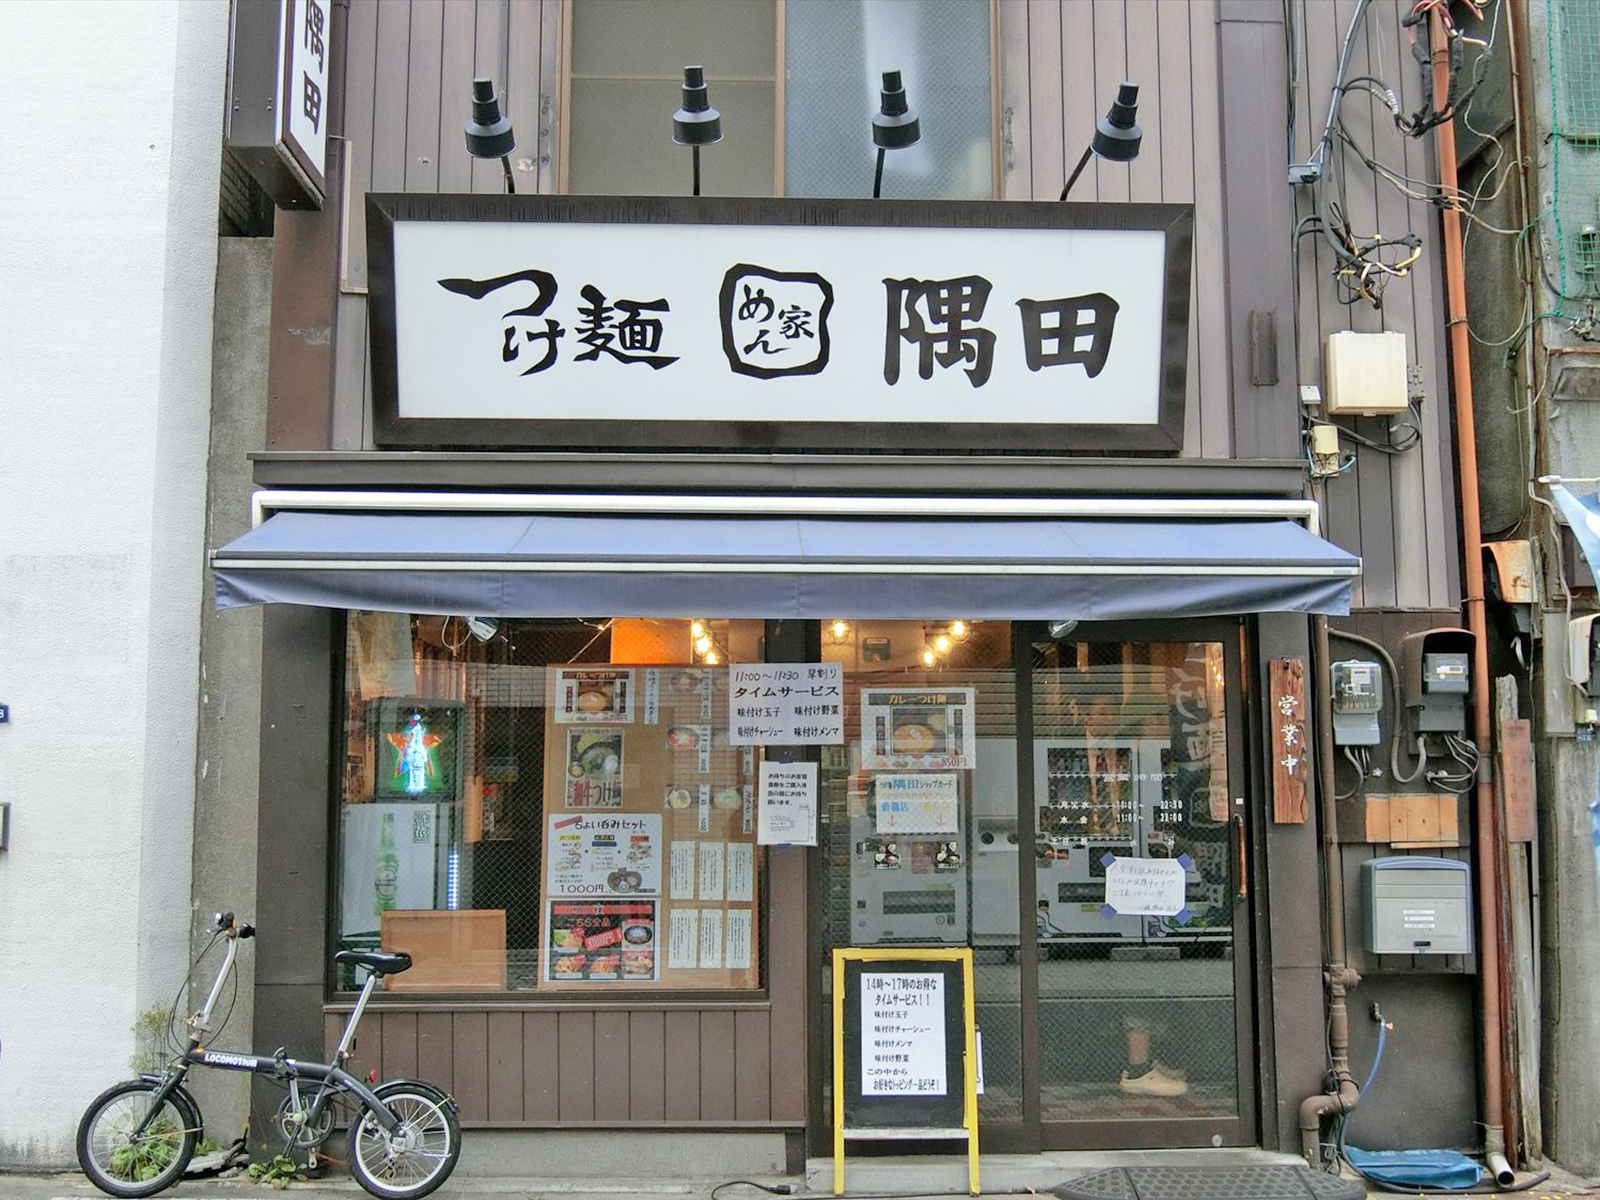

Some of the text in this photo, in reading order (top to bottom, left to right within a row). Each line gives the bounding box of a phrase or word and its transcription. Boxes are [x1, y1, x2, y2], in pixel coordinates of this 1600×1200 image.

[437, 268, 681, 377] つけ麺
[881, 275, 1121, 388] 隅田
[807, 668, 837, 680] 早割り
[734, 685, 839, 698] タイムサービス
[889, 694, 947, 704] カレーつけ麺
[737, 705, 839, 718] 味付け玉子 味付け野菜
[737, 726, 839, 738] 味付けチャーシュー 味付けメンマ
[1278, 695, 1299, 776] 営業中
[560, 884, 604, 893] 1000円
[874, 1010, 909, 1019] 味付け玉子
[874, 1025, 931, 1034] 味付けチャーシュー
[874, 1054, 910, 1063] 味付け野菜
[867, 1068, 908, 1076] この中から
